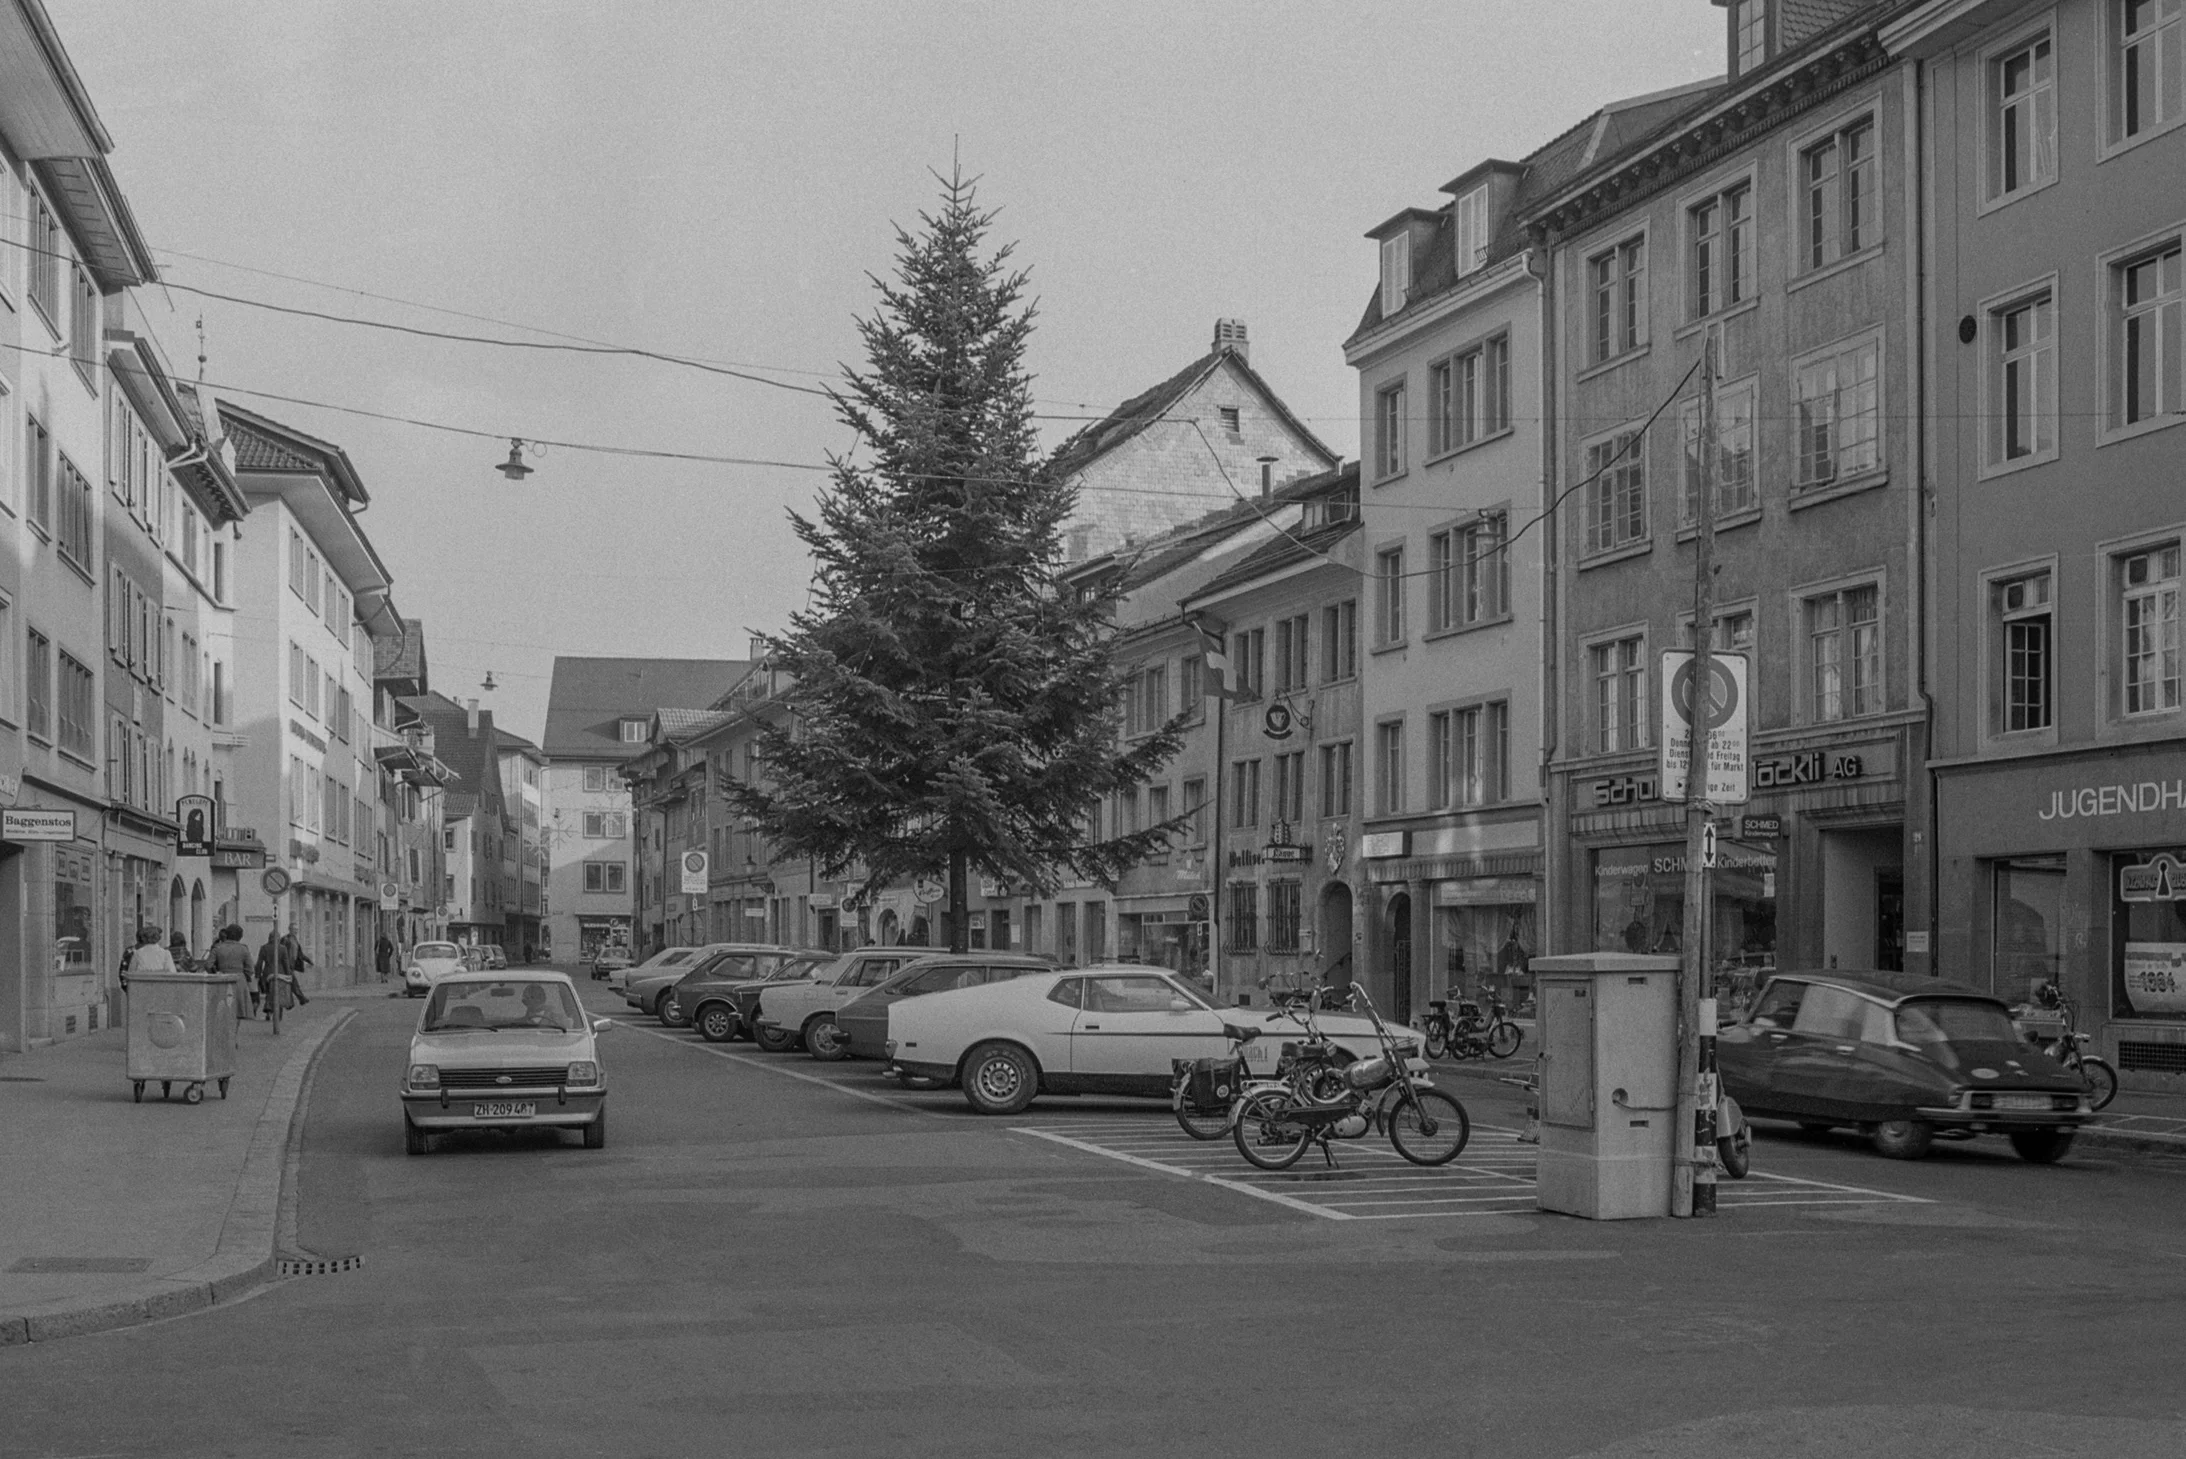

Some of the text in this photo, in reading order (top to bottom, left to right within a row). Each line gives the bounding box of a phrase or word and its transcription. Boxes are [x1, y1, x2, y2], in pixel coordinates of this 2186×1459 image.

[1711, 742, 1719, 750] ab
[1716, 751, 1741, 762] Freitag
[1666, 760, 1677, 769] bis
[1711, 762, 1721, 771] für
[1723, 762, 1744, 772] Markt
[1832, 756, 1858, 778] AG
[1721, 782, 1736, 792] Zeit
[2038, 779, 2186, 820] JUGENDH
[5, 815, 72, 828] Baggenstos
[1744, 819, 1779, 830] SCHMED
[224, 852, 252, 867] BAR
